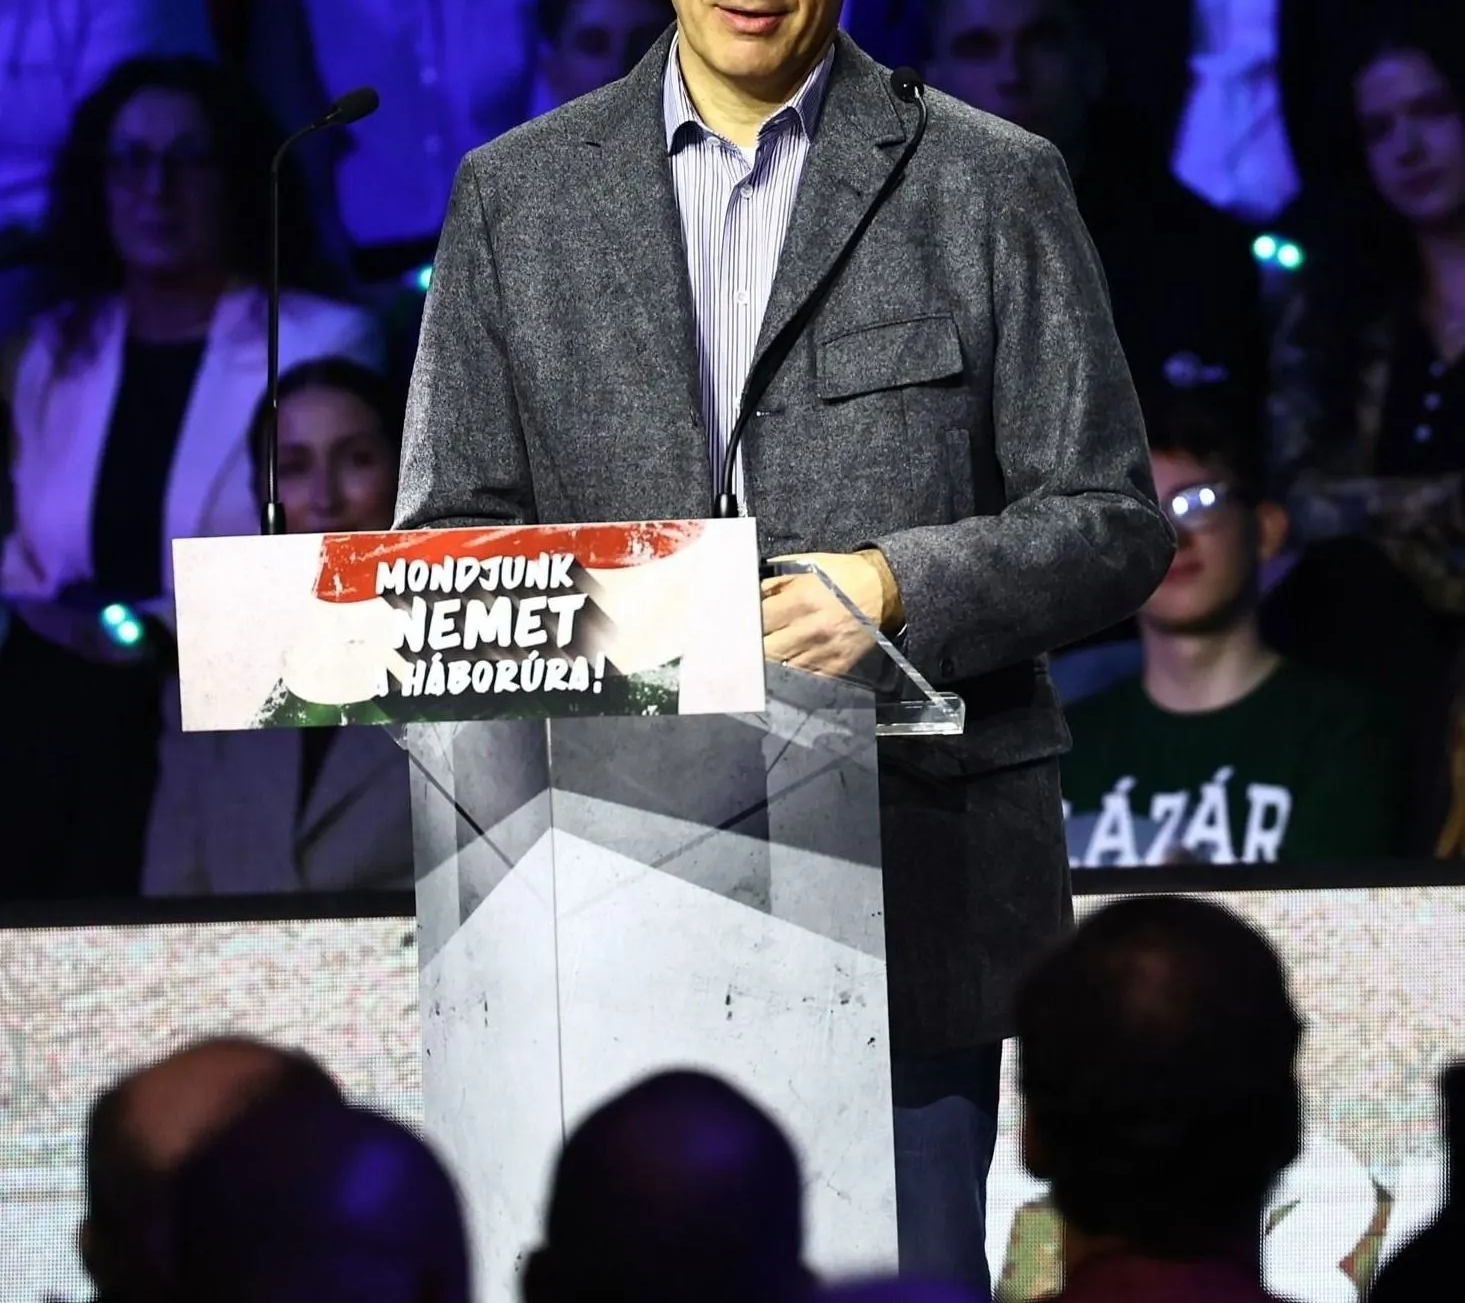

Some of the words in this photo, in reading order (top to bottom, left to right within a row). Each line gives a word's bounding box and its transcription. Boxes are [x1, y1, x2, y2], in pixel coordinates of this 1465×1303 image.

[376, 552, 575, 594] MONDJUNK
[393, 593, 588, 652] NEMET
[401, 650, 605, 697] HÁBORÚRA!
[1062, 765, 1292, 867] ÁZÁR
